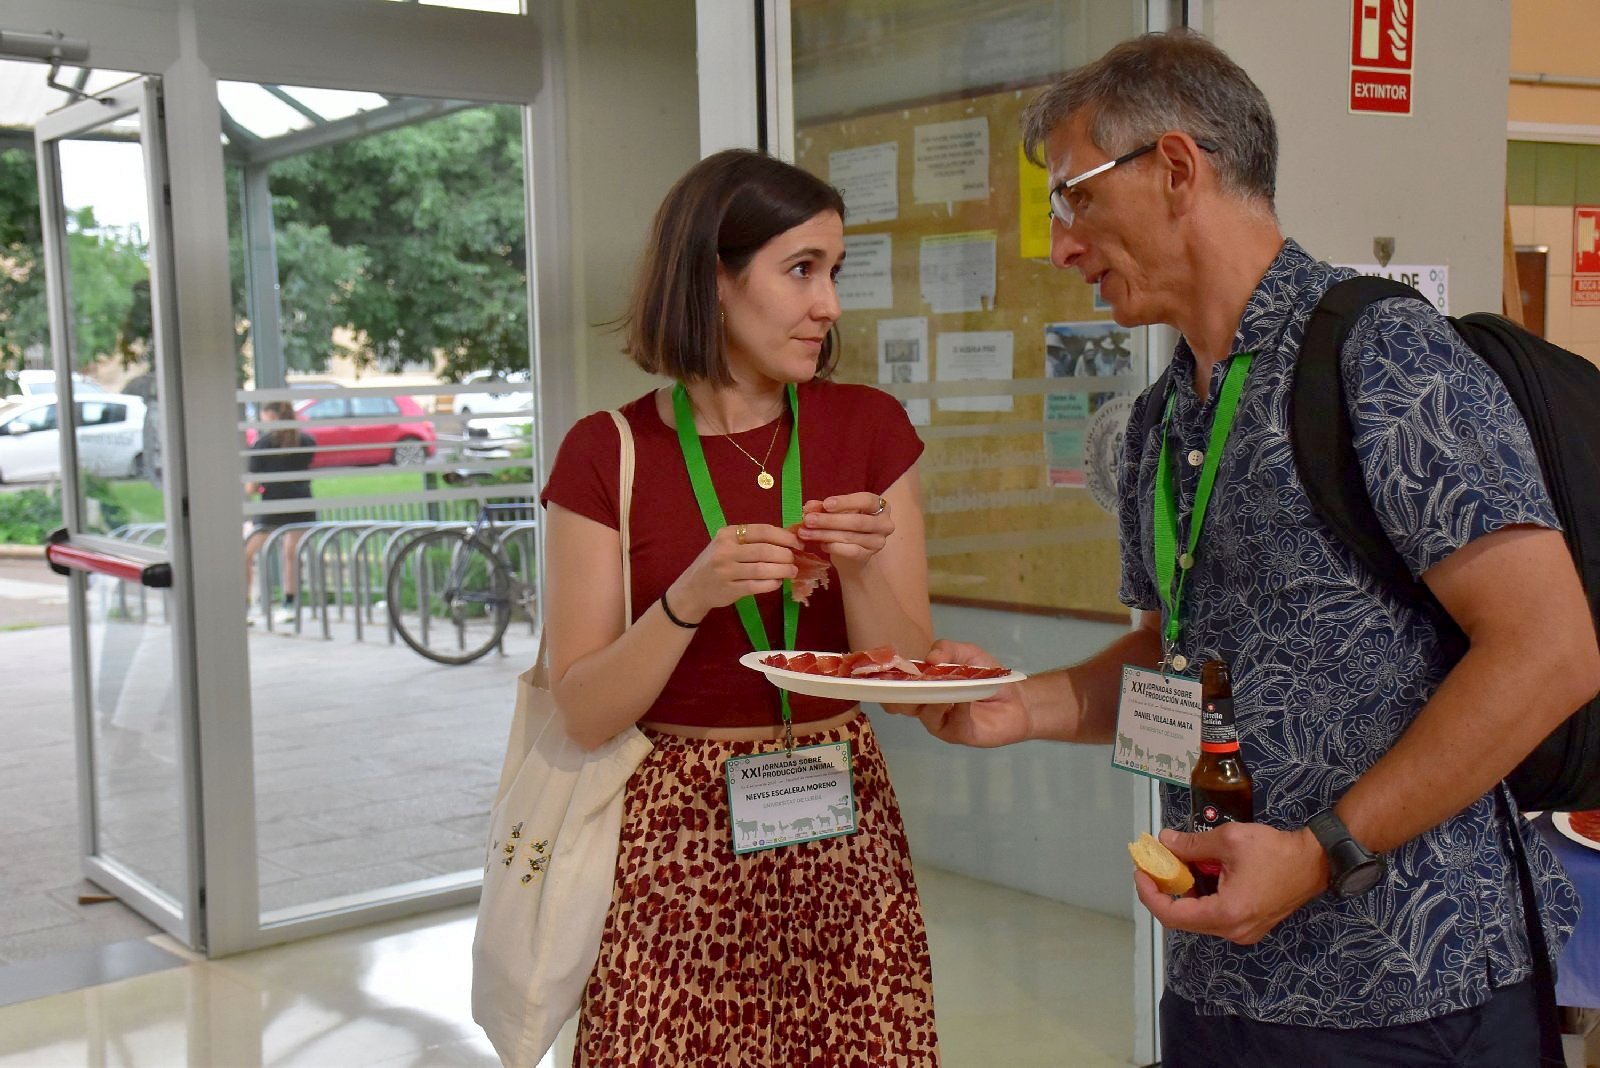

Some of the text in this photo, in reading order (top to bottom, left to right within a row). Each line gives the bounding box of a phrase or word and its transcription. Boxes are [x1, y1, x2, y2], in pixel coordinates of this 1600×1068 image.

[1354, 82, 1407, 100] EXTINTOR
[1131, 681, 1146, 694] XXI
[1145, 683, 1193, 699] JORNADAS SOBRE
[1145, 691, 1179, 705] PRODUCCIÓN
[1179, 699, 1202, 710] ANIMAL
[1134, 710, 1152, 721] DANIEL
[1152, 715, 1176, 727] VILLALBA
[1177, 720, 1193, 730] MATA
[762, 756, 822, 771] JORNADAS SOBRE
[762, 766, 807, 779] PRODUCCIÓN
[809, 761, 835, 771] ANIMAL
[741, 766, 761, 780] XXI
[745, 791, 770, 801] NIEVES
[771, 785, 806, 797] ESCALERA
[806, 780, 837, 792] MORENO
